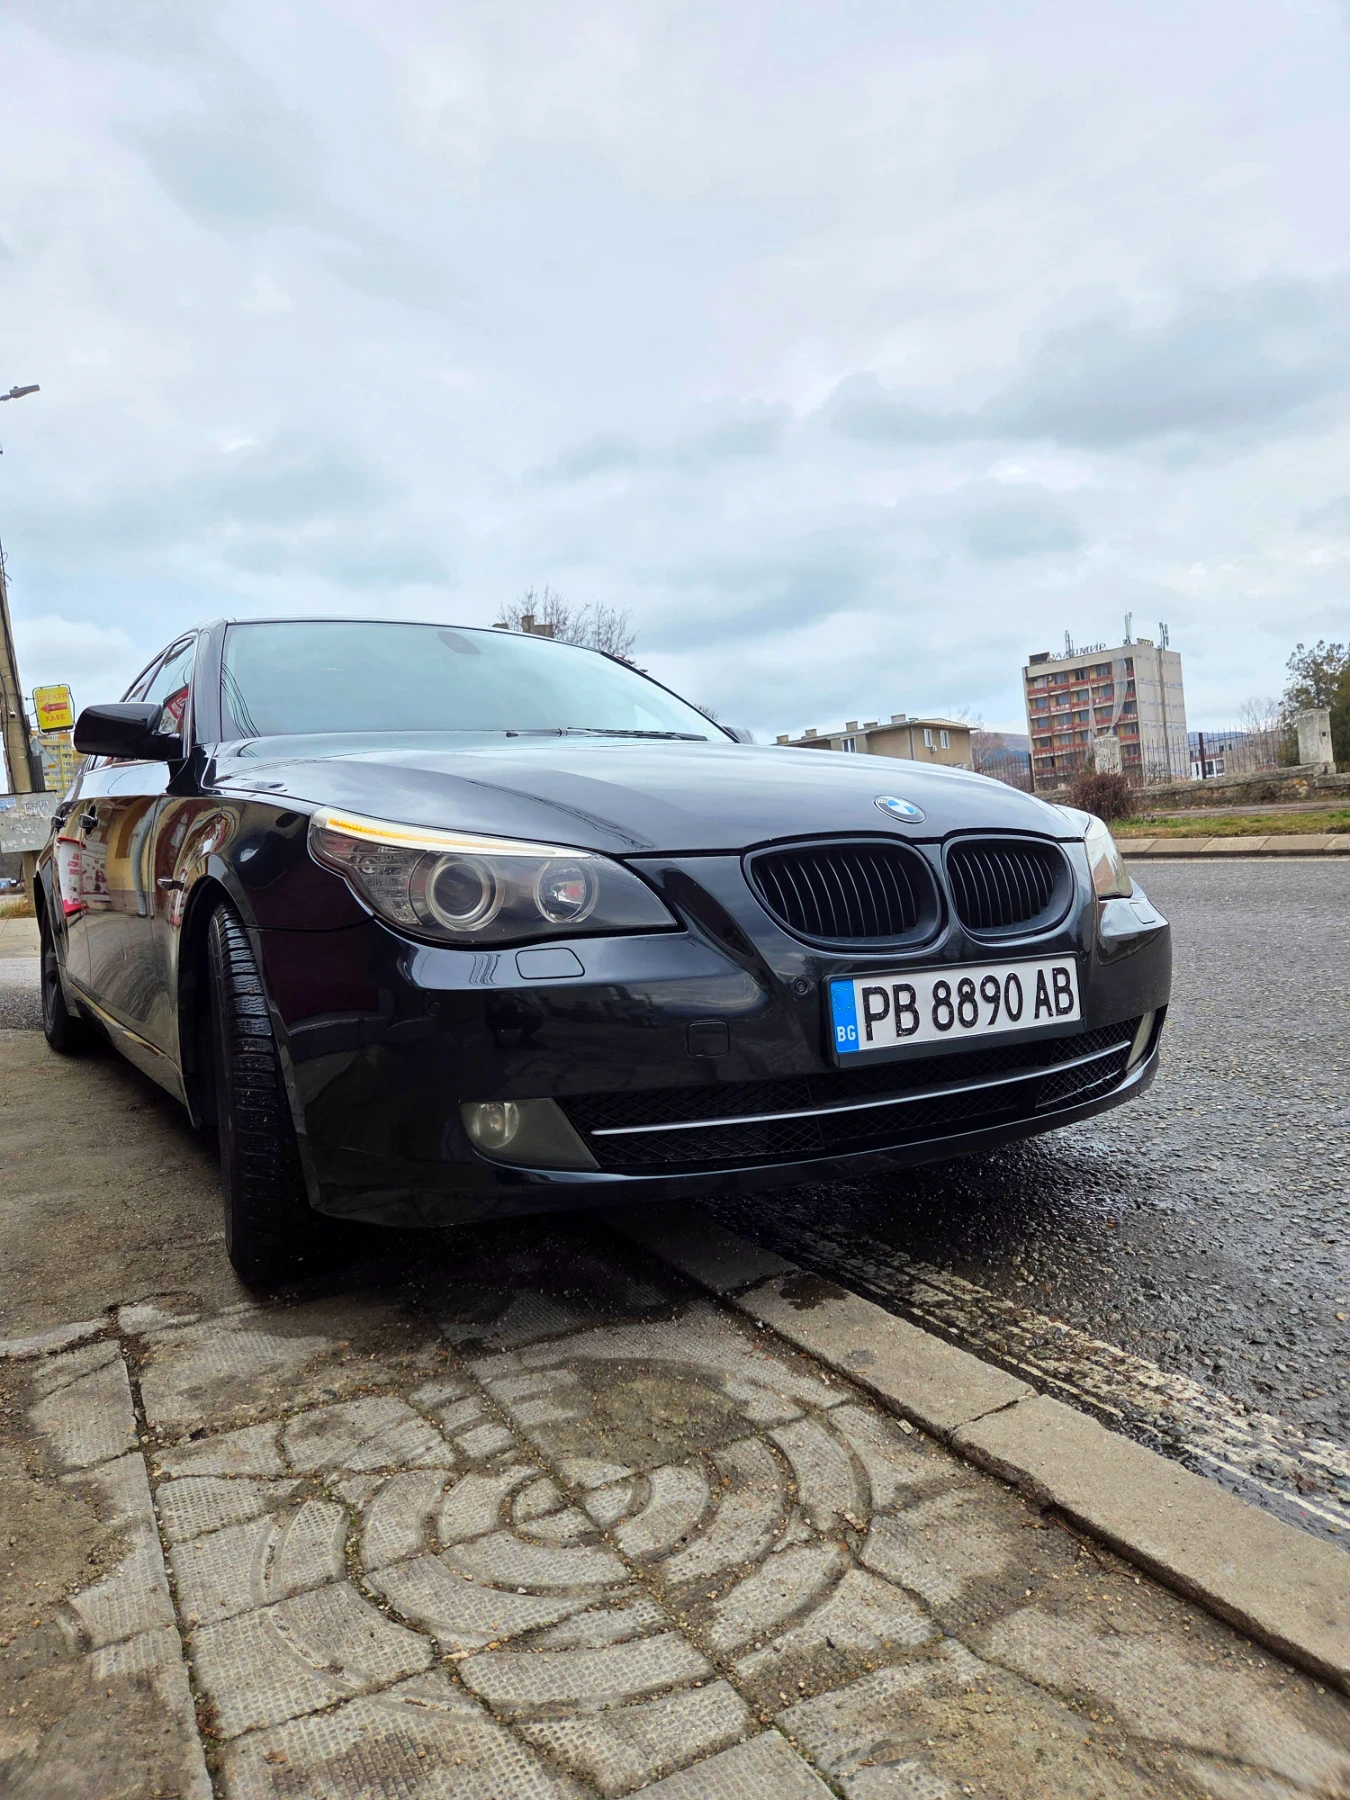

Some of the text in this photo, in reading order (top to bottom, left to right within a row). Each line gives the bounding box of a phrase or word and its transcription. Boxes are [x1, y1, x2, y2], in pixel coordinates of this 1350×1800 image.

[45, 713, 66, 722] КАФЕ
[861, 966, 1075, 1041] PB 8890 AB
[836, 1025, 856, 1043] BG
